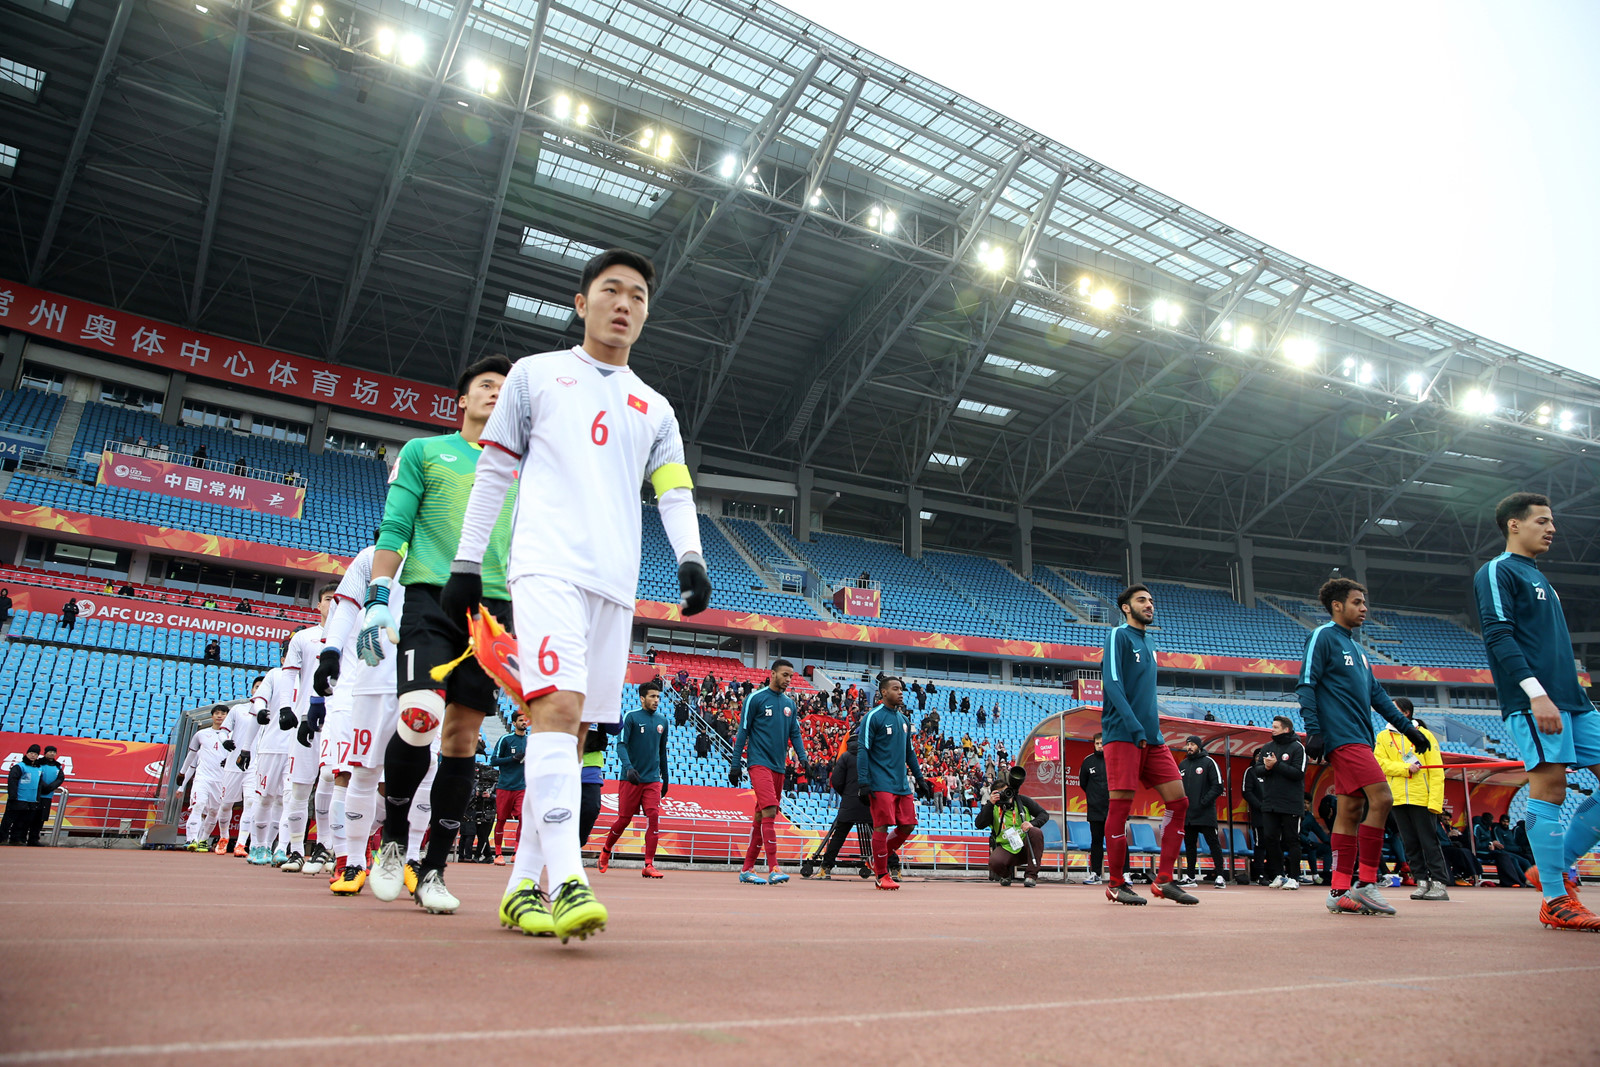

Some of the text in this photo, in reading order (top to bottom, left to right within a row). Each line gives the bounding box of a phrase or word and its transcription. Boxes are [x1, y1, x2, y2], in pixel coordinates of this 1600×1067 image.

[591, 411, 608, 445] 6
[164, 472, 246, 501] 中国·常州
[1535, 588, 1546, 600] 22
[97, 605, 291, 641] AFC U23 CHAMPIONSHIP
[538, 636, 559, 676] 6
[1135, 653, 1141, 663] 2
[1343, 655, 1354, 666] 23
[404, 649, 415, 682] 1
[213, 742, 219, 751] 4
[353, 728, 372, 755] 19
[337, 741, 351, 764] 17
[1056, 766, 1071, 775] U3
[661, 806, 744, 816] CHAMPIONSHIP
[665, 811, 713, 819] CHINA
